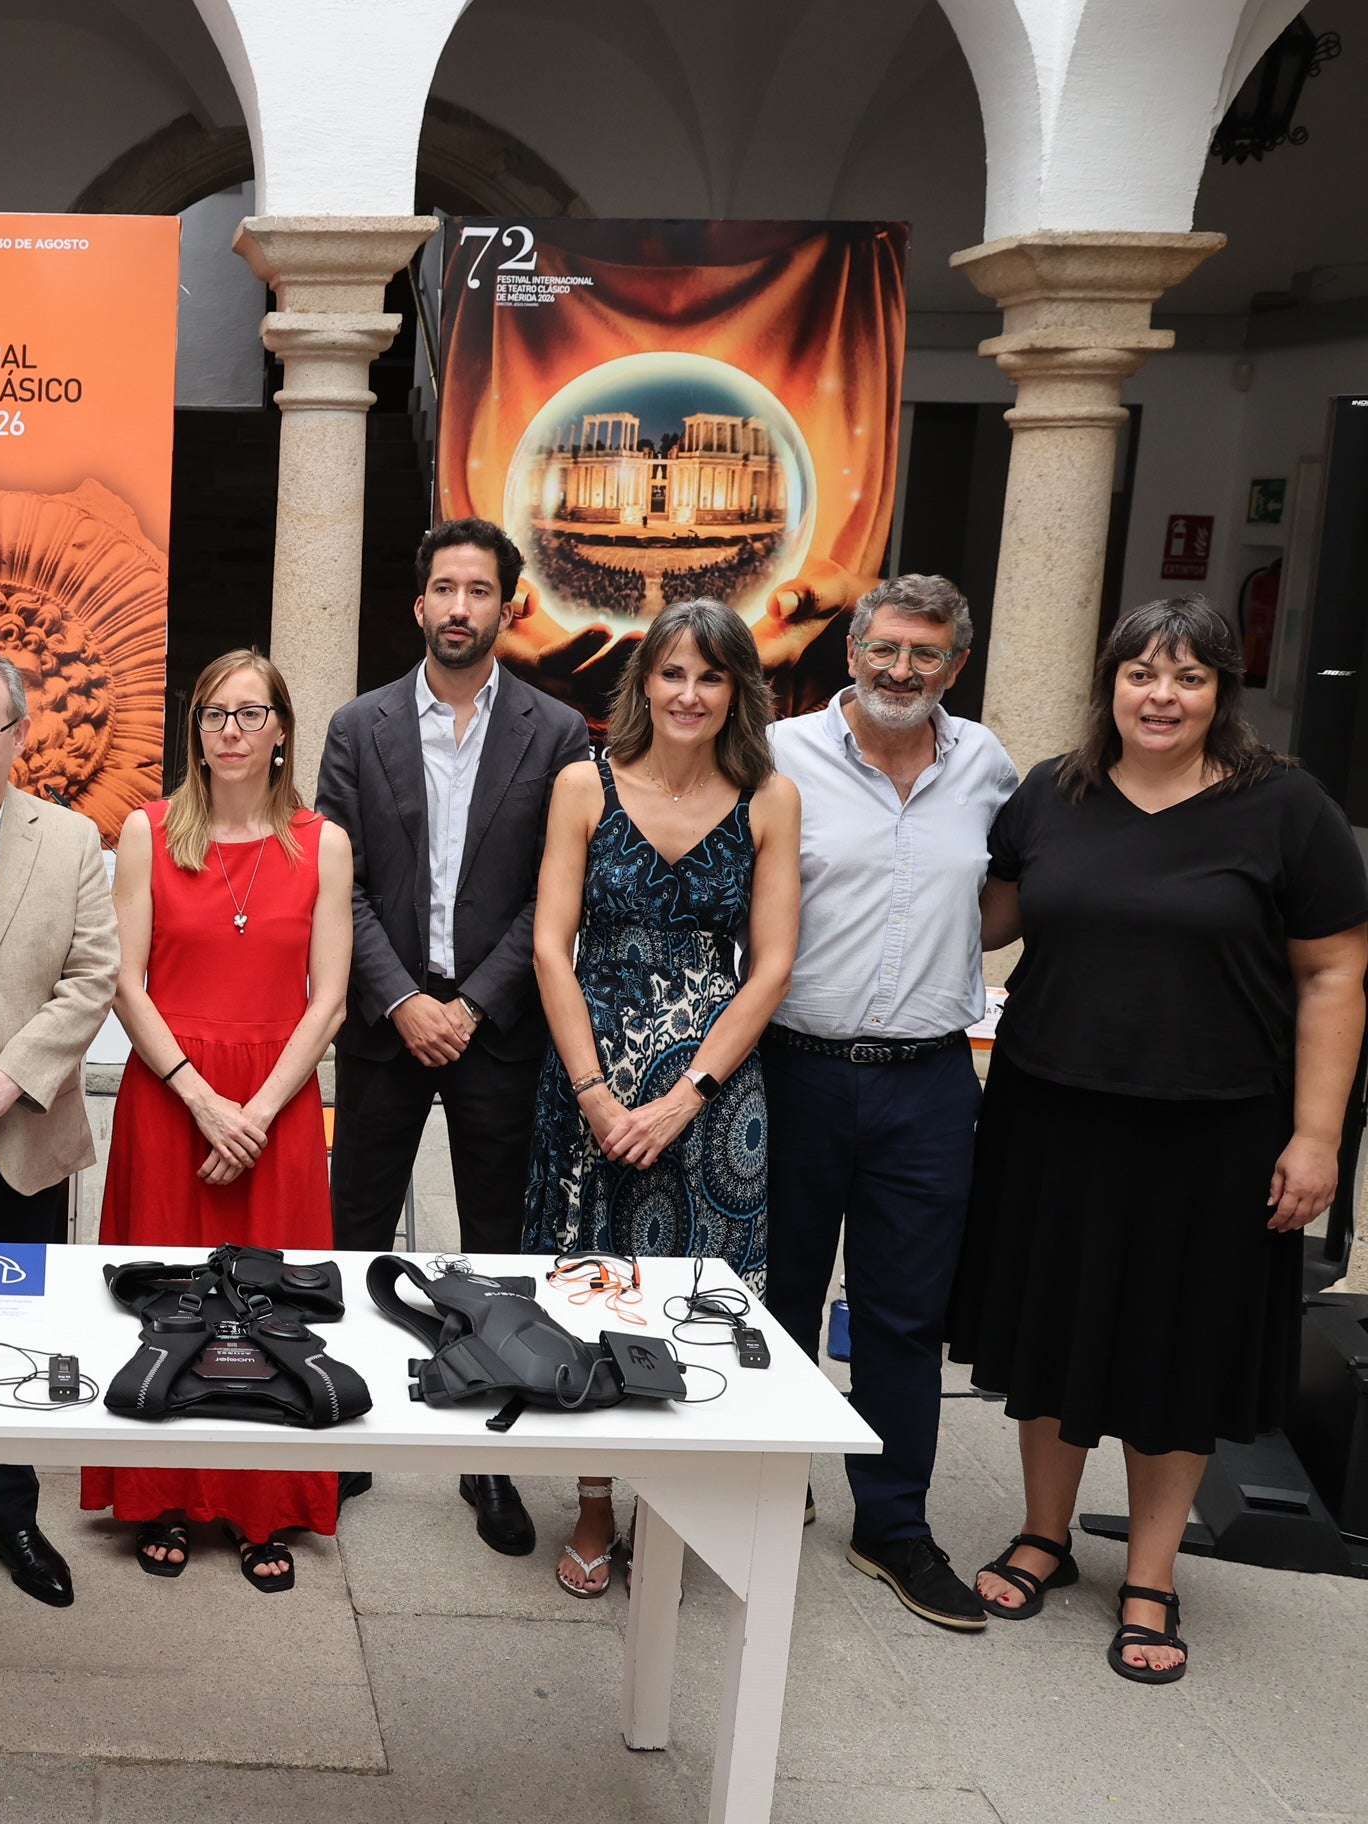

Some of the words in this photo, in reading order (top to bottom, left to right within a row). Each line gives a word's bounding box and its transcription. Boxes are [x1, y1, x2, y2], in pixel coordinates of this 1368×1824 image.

[15, 238, 32, 249] DE
[34, 239, 89, 250] AGOSTO
[460, 225, 538, 289] 72
[497, 275, 531, 285] FESTIVAL
[532, 276, 594, 286] INTERNACIONAL
[496, 284, 507, 293] DE
[508, 284, 537, 293] TEATRO
[538, 283, 570, 294] CLÁSICO
[496, 293, 506, 302] DE
[507, 291, 537, 302] MÉRIDA
[538, 294, 555, 303] 2026
